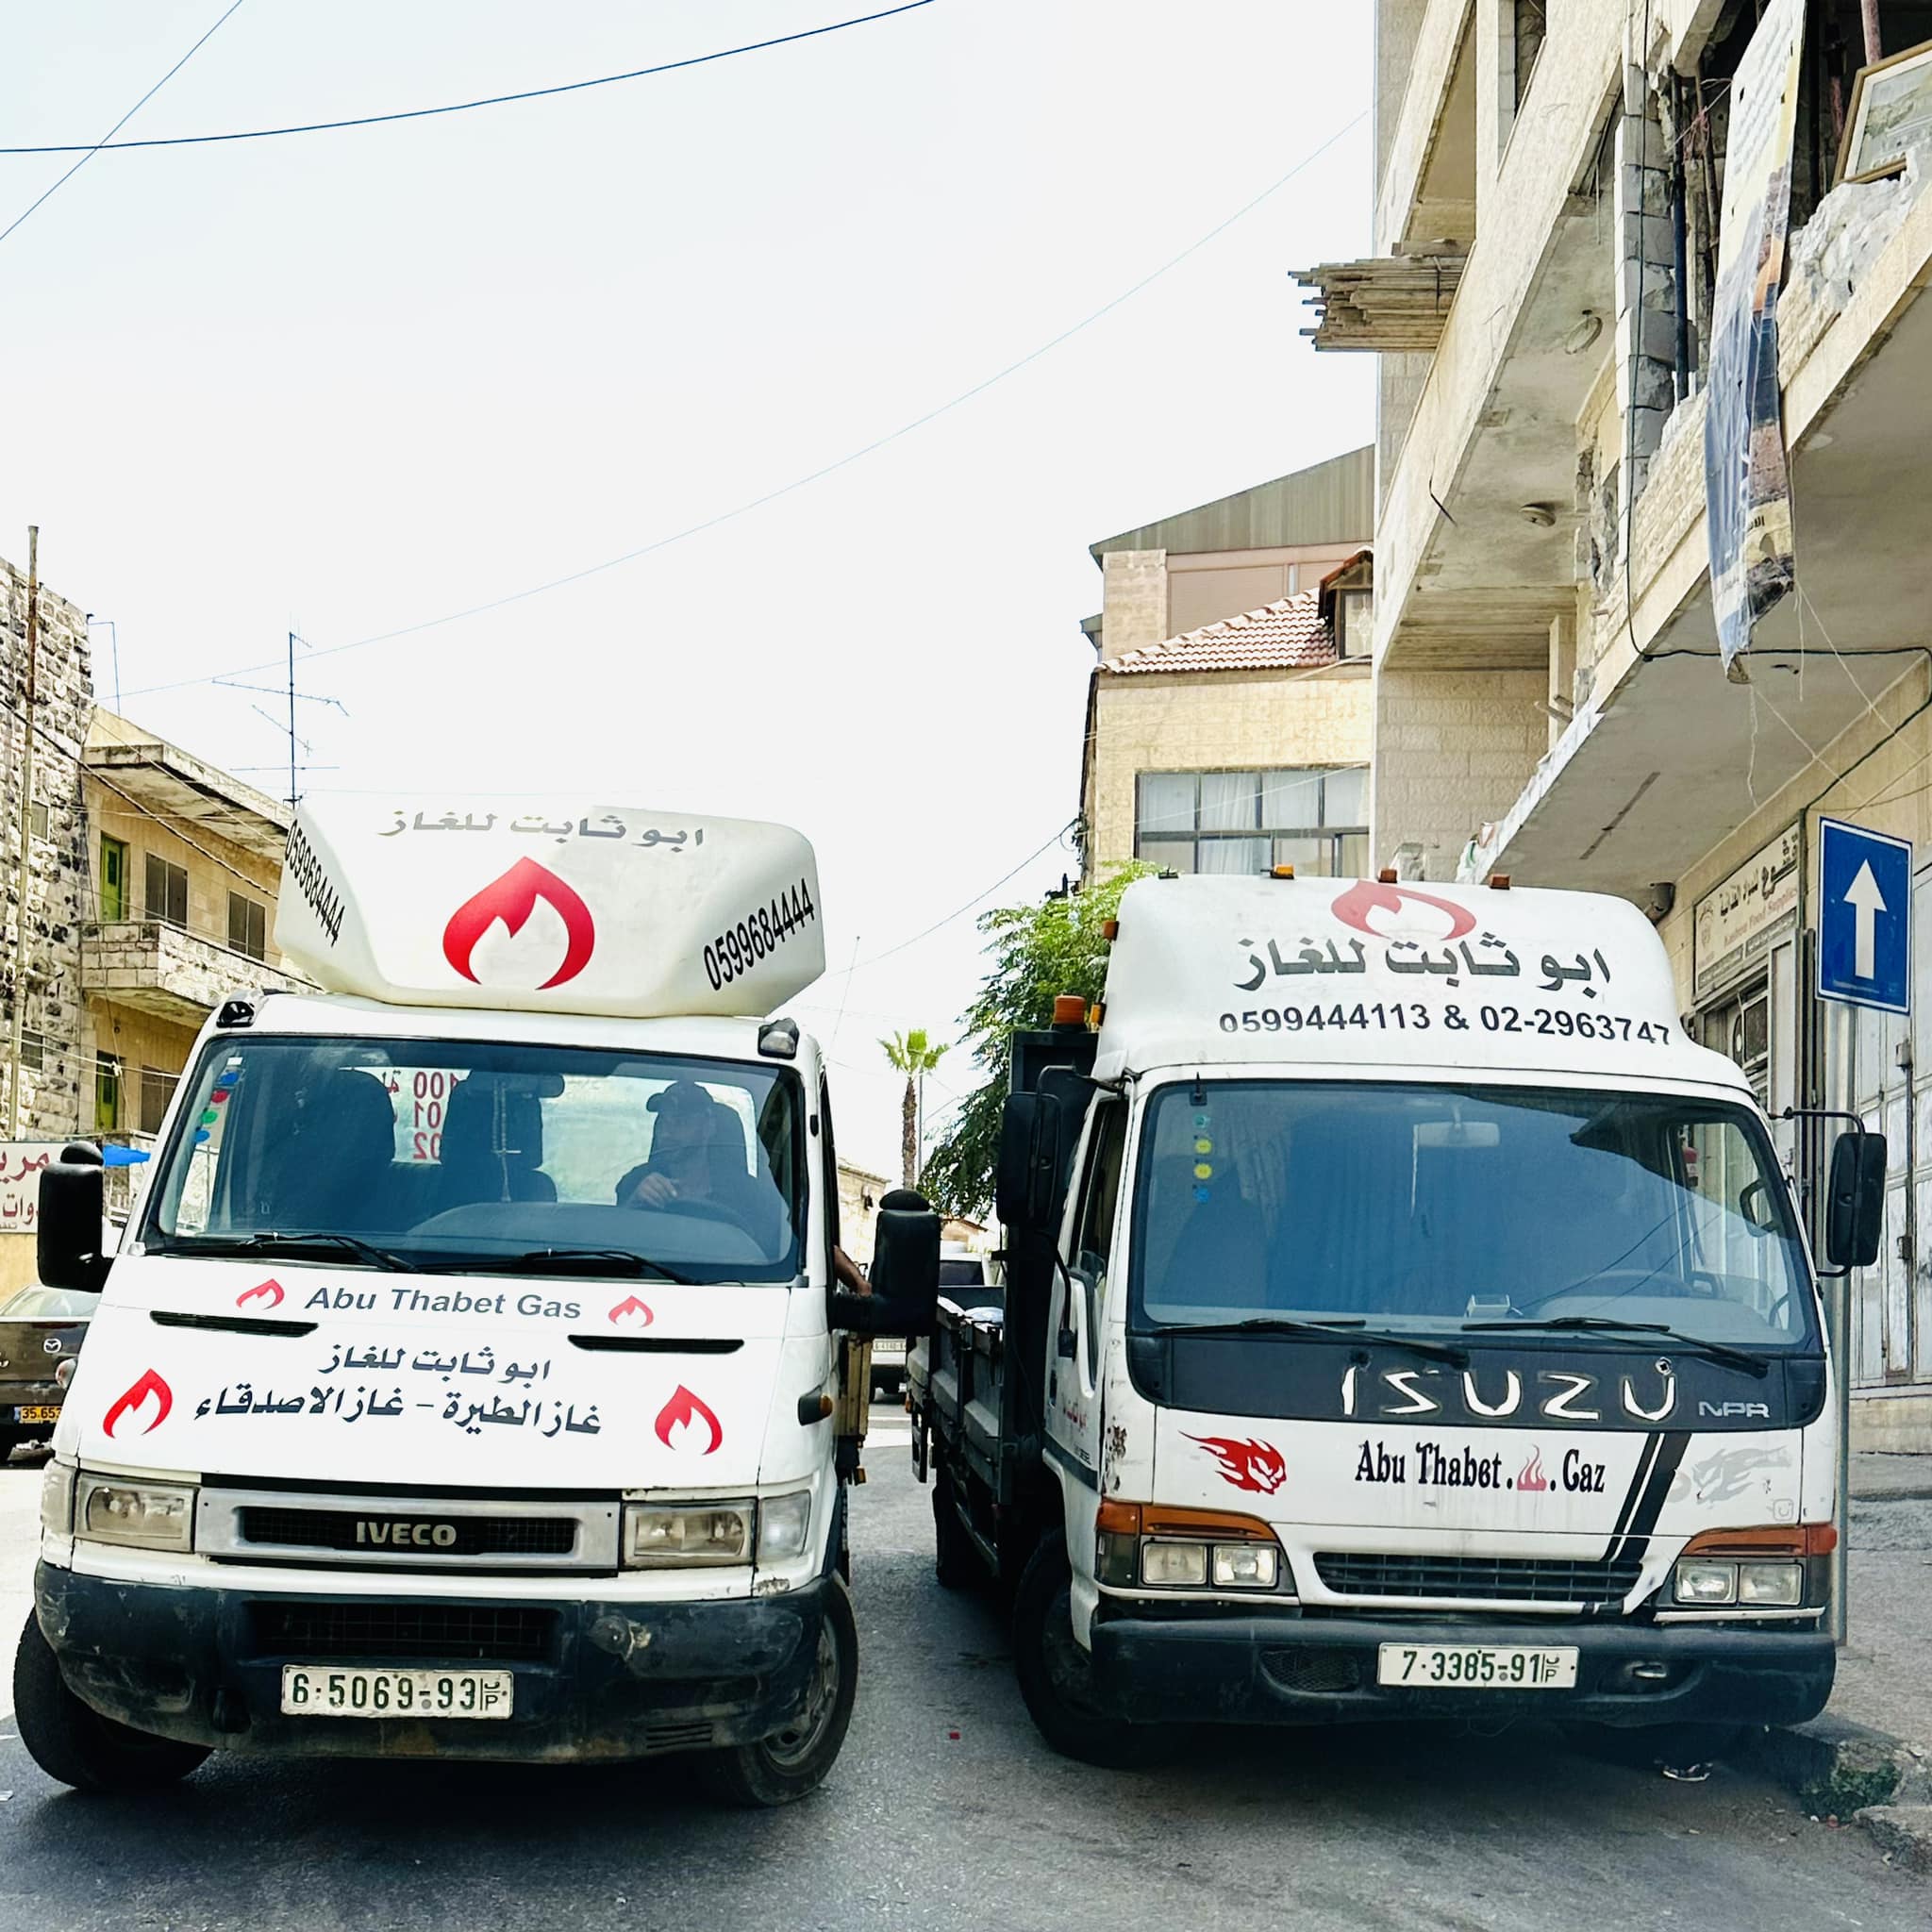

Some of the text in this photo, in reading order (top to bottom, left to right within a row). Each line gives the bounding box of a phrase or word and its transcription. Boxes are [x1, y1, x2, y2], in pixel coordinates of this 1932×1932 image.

[377, 810, 704, 853] ابو ثابت للغاز
[285, 819, 345, 947] 0599684444
[704, 877, 815, 991] 0599684444
[1232, 931, 1610, 999] ابو ثابت للغاز
[1219, 1004, 1671, 1046] 0599444113 & 02-2963747
[305, 1288, 582, 1319] Abu Thabet Gas
[318, 1343, 551, 1389] ابو ثابت للغاز
[1341, 1366, 1771, 1422] ISUZU NPR
[1355, 1440, 1406, 1484] Abu
[356, 1521, 457, 1546] IVECO
